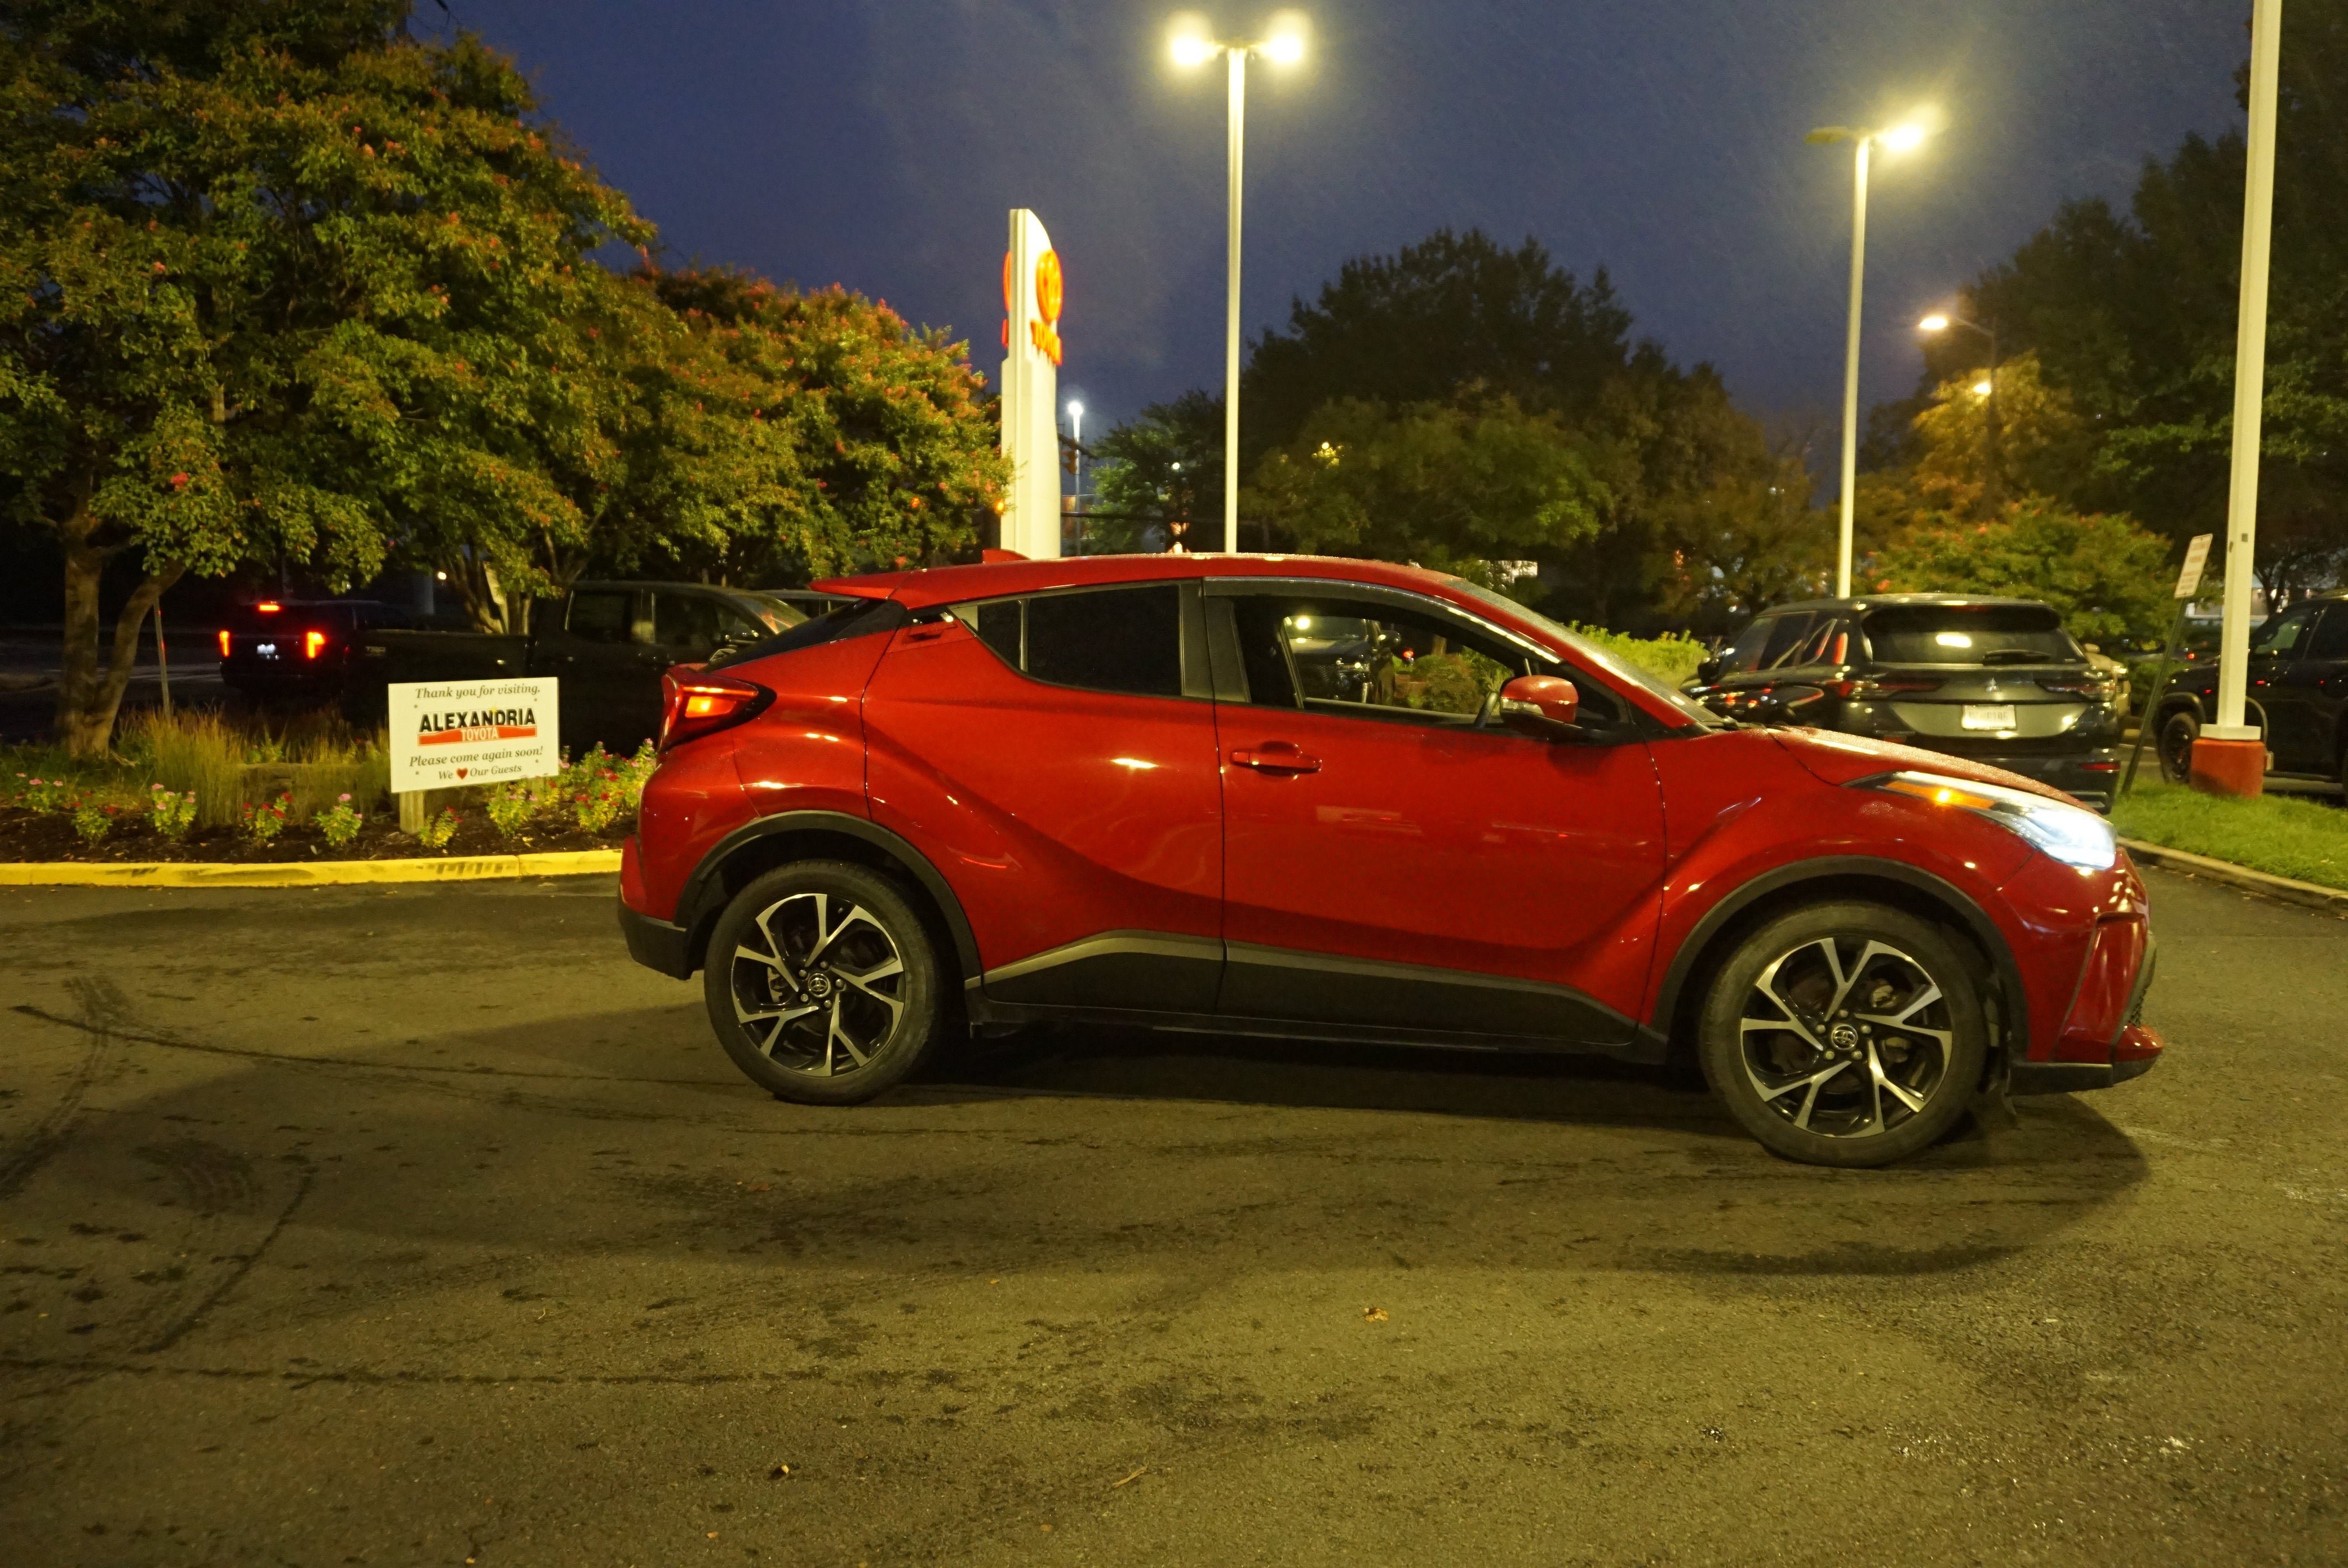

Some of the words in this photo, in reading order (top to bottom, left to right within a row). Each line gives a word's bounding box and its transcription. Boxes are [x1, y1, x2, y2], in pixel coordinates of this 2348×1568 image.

[415, 687, 453, 699] Thank
[455, 688, 477, 699] you
[476, 685, 495, 698] for
[498, 683, 540, 695] visiting.
[419, 708, 536, 733] ALEXANDRIA
[460, 726, 499, 741] TOYOTA
[409, 755, 447, 767] Please
[450, 754, 479, 763] come
[482, 748, 512, 762] again
[514, 745, 543, 757] soon!
[438, 770, 453, 780] We
[470, 767, 488, 777] Our
[491, 765, 522, 775] Guests
